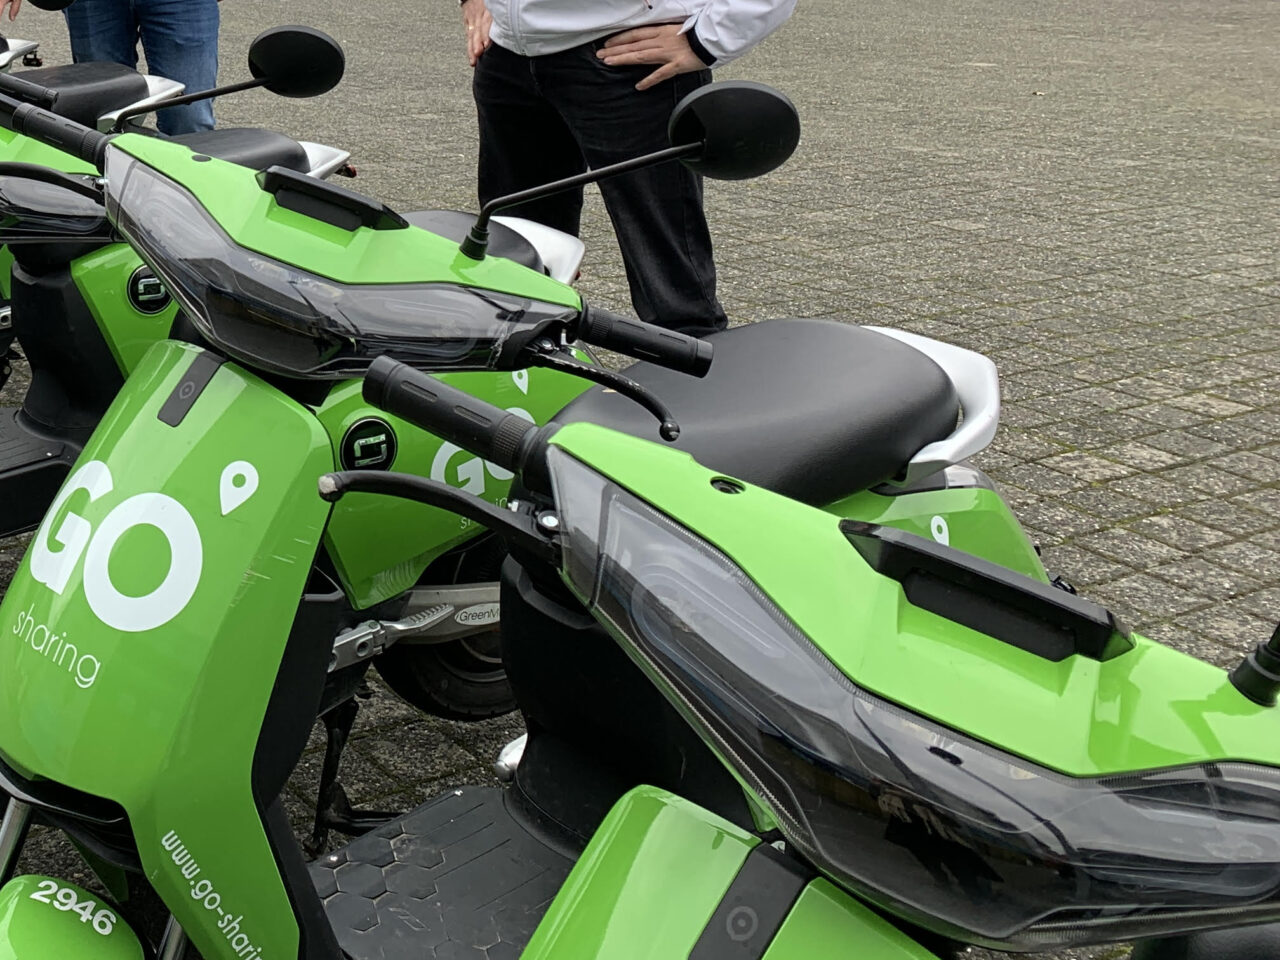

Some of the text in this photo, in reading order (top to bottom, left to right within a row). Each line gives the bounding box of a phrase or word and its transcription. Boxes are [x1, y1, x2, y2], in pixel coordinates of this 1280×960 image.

[29, 459, 203, 633] GO
[12, 603, 101, 688] sharing
[459, 604, 500, 622] GreenM
[29, 880, 117, 936] 2946
[161, 829, 265, 960] www.go-shari
